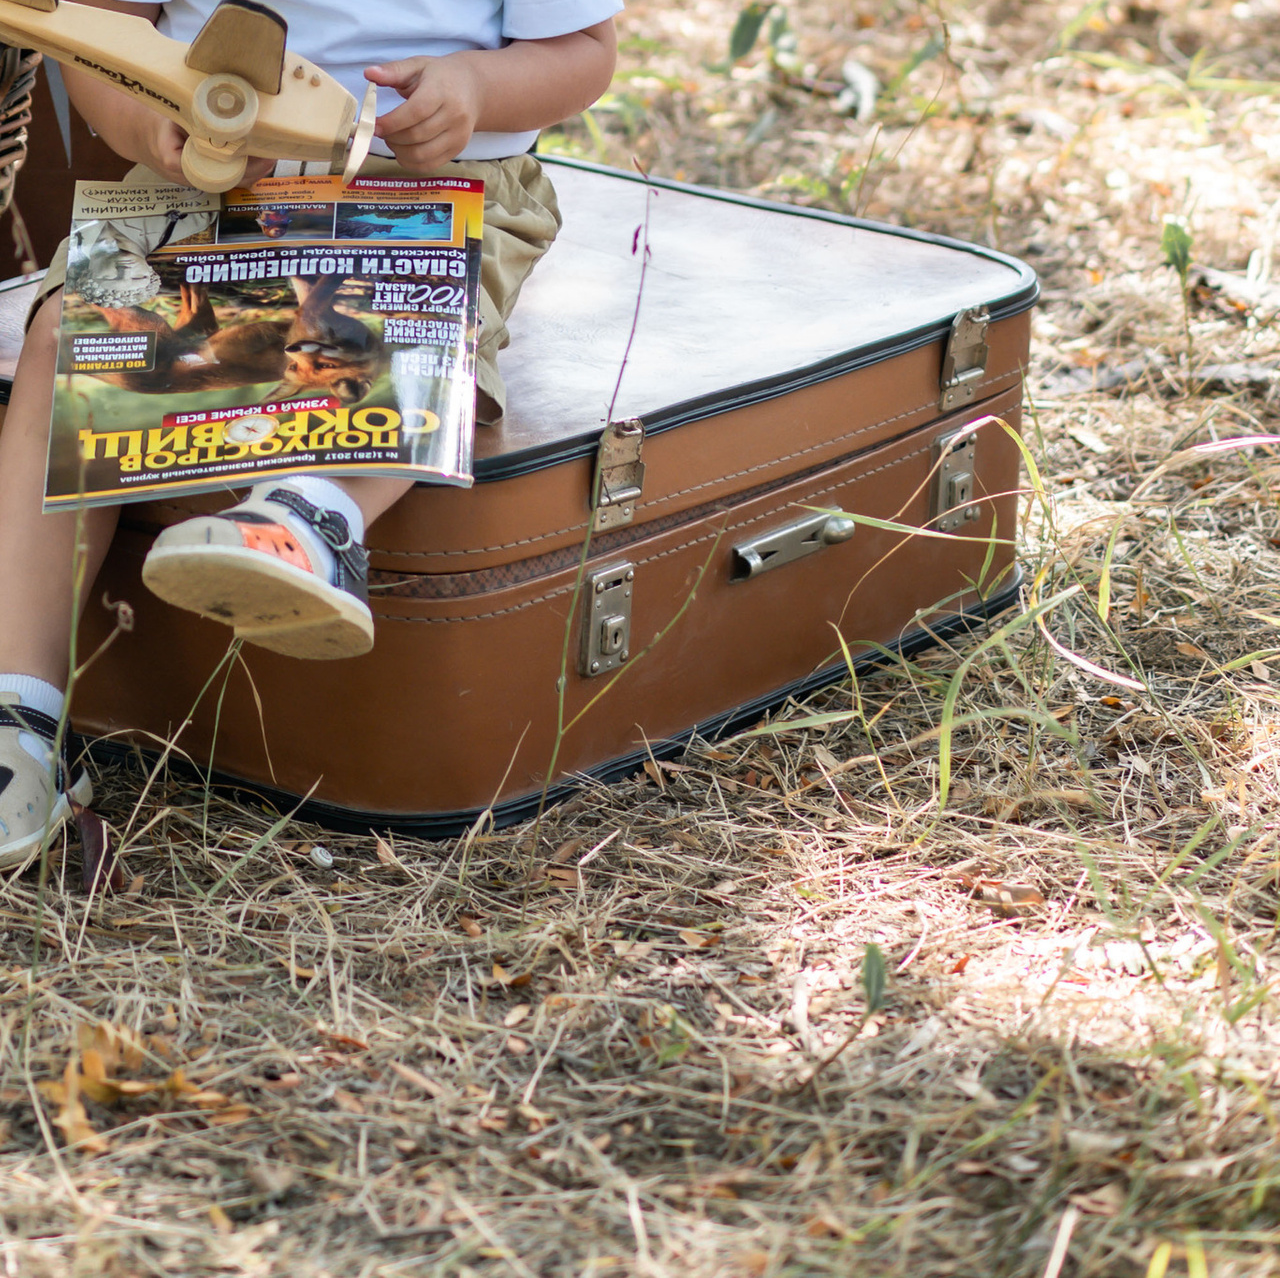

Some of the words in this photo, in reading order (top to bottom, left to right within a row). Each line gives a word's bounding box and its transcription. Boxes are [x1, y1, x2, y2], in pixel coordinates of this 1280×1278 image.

[355, 179, 418, 189] ПОДПИСКА!
[419, 180, 471, 189] ОТКРЫТА
[81, 203, 157, 214] МЕДИЦИНЫ
[165, 200, 210, 210] ГЕНИИ
[227, 205, 270, 213] ТУРИСТЫ
[272, 203, 327, 211] МАЛЕНЬКИЕ
[229, 249, 275, 261] время
[303, 248, 386, 257] винзаводы
[391, 249, 467, 260] Крымские
[176, 254, 225, 264] войны
[185, 257, 354, 284] КОЛЛЕКЦИЮ
[361, 258, 466, 278] СПАСТИ
[374, 281, 416, 292] НАЗАД
[372, 291, 405, 303] ЛЕТ
[406, 284, 464, 306] 100
[371, 302, 419, 312] СИМЕИЗ
[420, 304, 463, 315] КУРОРТ
[384, 318, 462, 331] КАТАСТРОФЫ
[384, 326, 461, 341] МОРСКИЕ
[73, 336, 148, 345] ПОЛУОСТРОВЕ!
[81, 344, 148, 353] МАТЕРИАЛОВ
[74, 352, 144, 362] УНИКАЛЬНЫХ
[126, 360, 147, 369] 100
[266, 404, 277, 413] О
[281, 398, 329, 414] УЗНАЙ
[175, 412, 206, 424] ВСЕ!
[210, 406, 262, 421] КРЫМЕ
[119, 430, 398, 472] ПОЛУОСТРОВ
[324, 452, 351, 460] 2017
[353, 450, 383, 460] 1(28)
[256, 454, 316, 469] Крымский
[161, 461, 254, 479] познавательный
[119, 473, 161, 483] журнал
